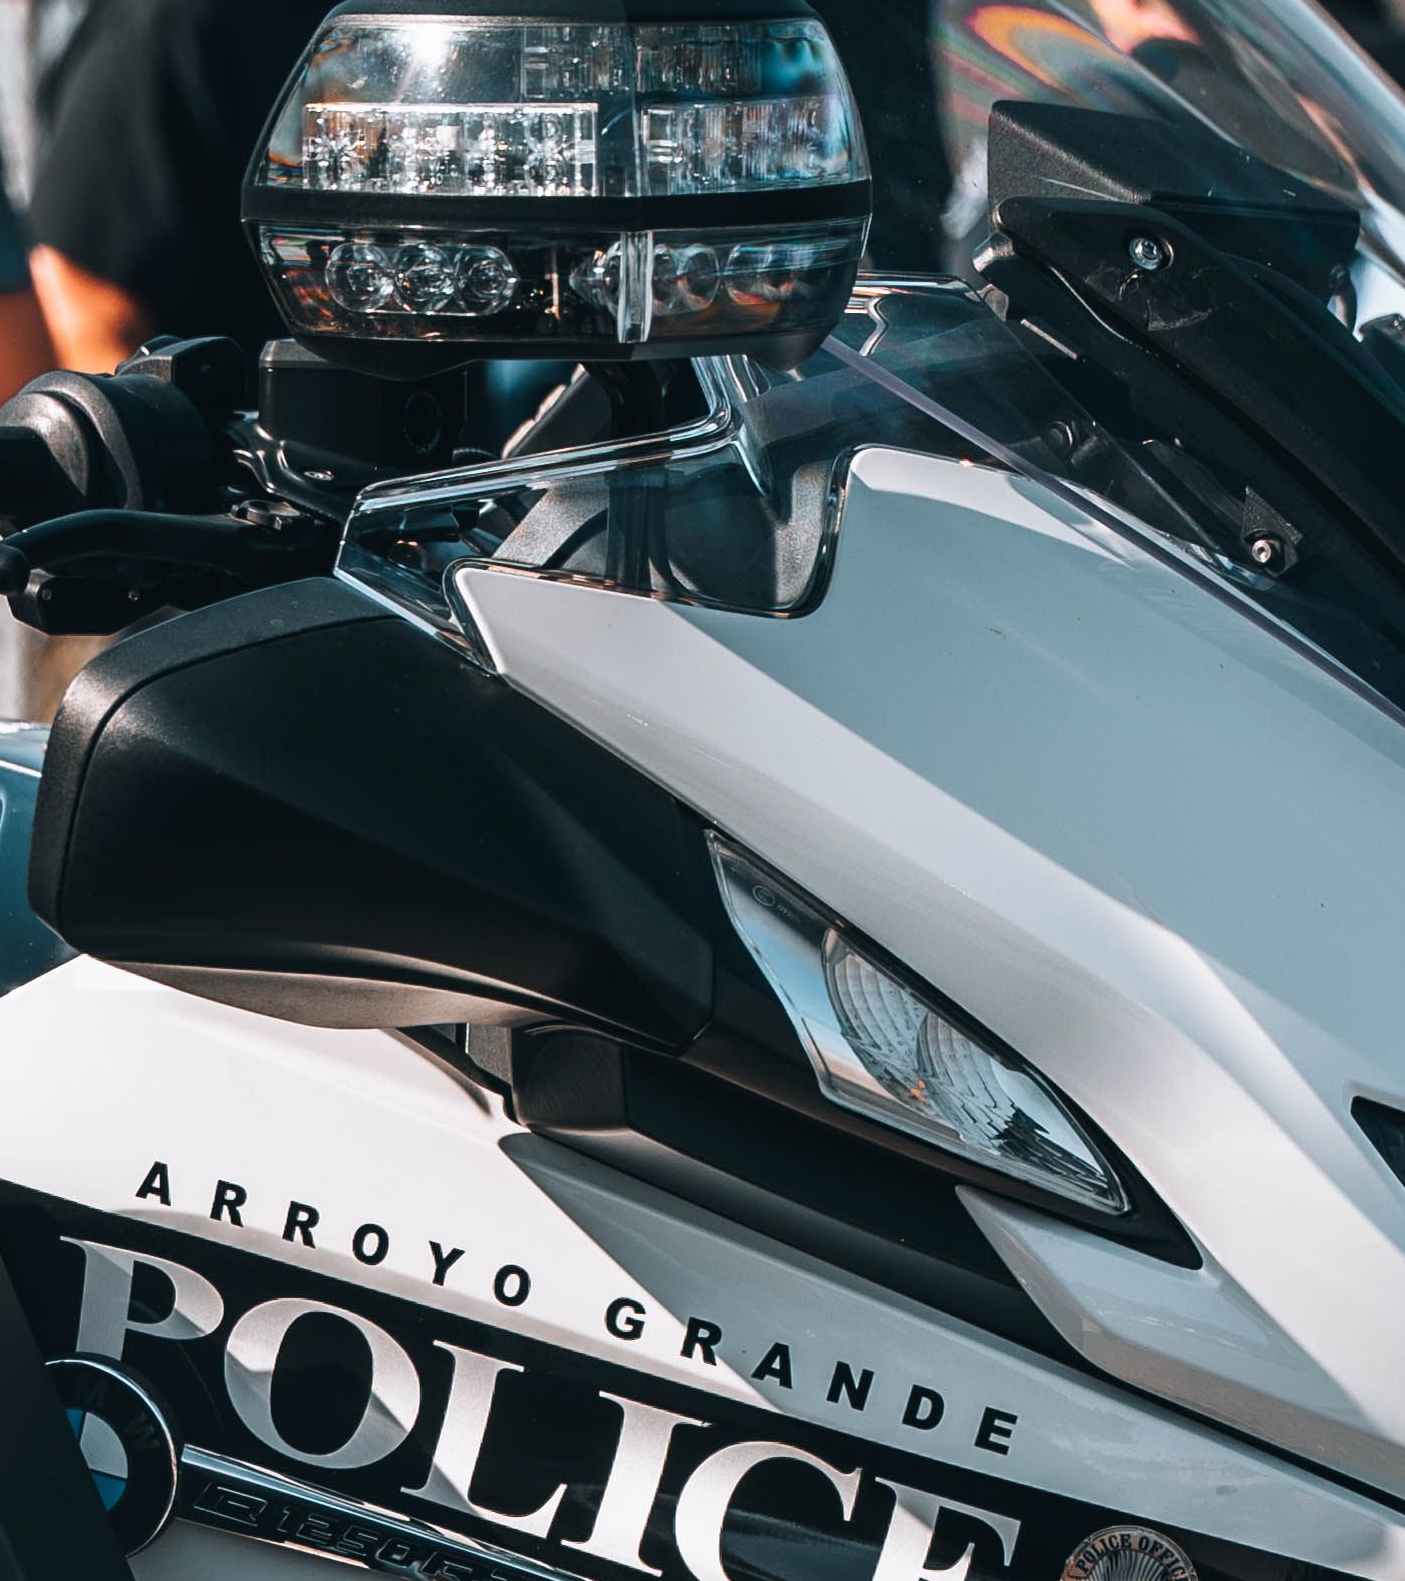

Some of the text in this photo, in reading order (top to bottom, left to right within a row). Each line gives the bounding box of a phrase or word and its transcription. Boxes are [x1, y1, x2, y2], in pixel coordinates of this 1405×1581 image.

[135, 1160, 1019, 1456] ARROYO GRANDE
[1076, 1532, 1132, 1576] POLICE
